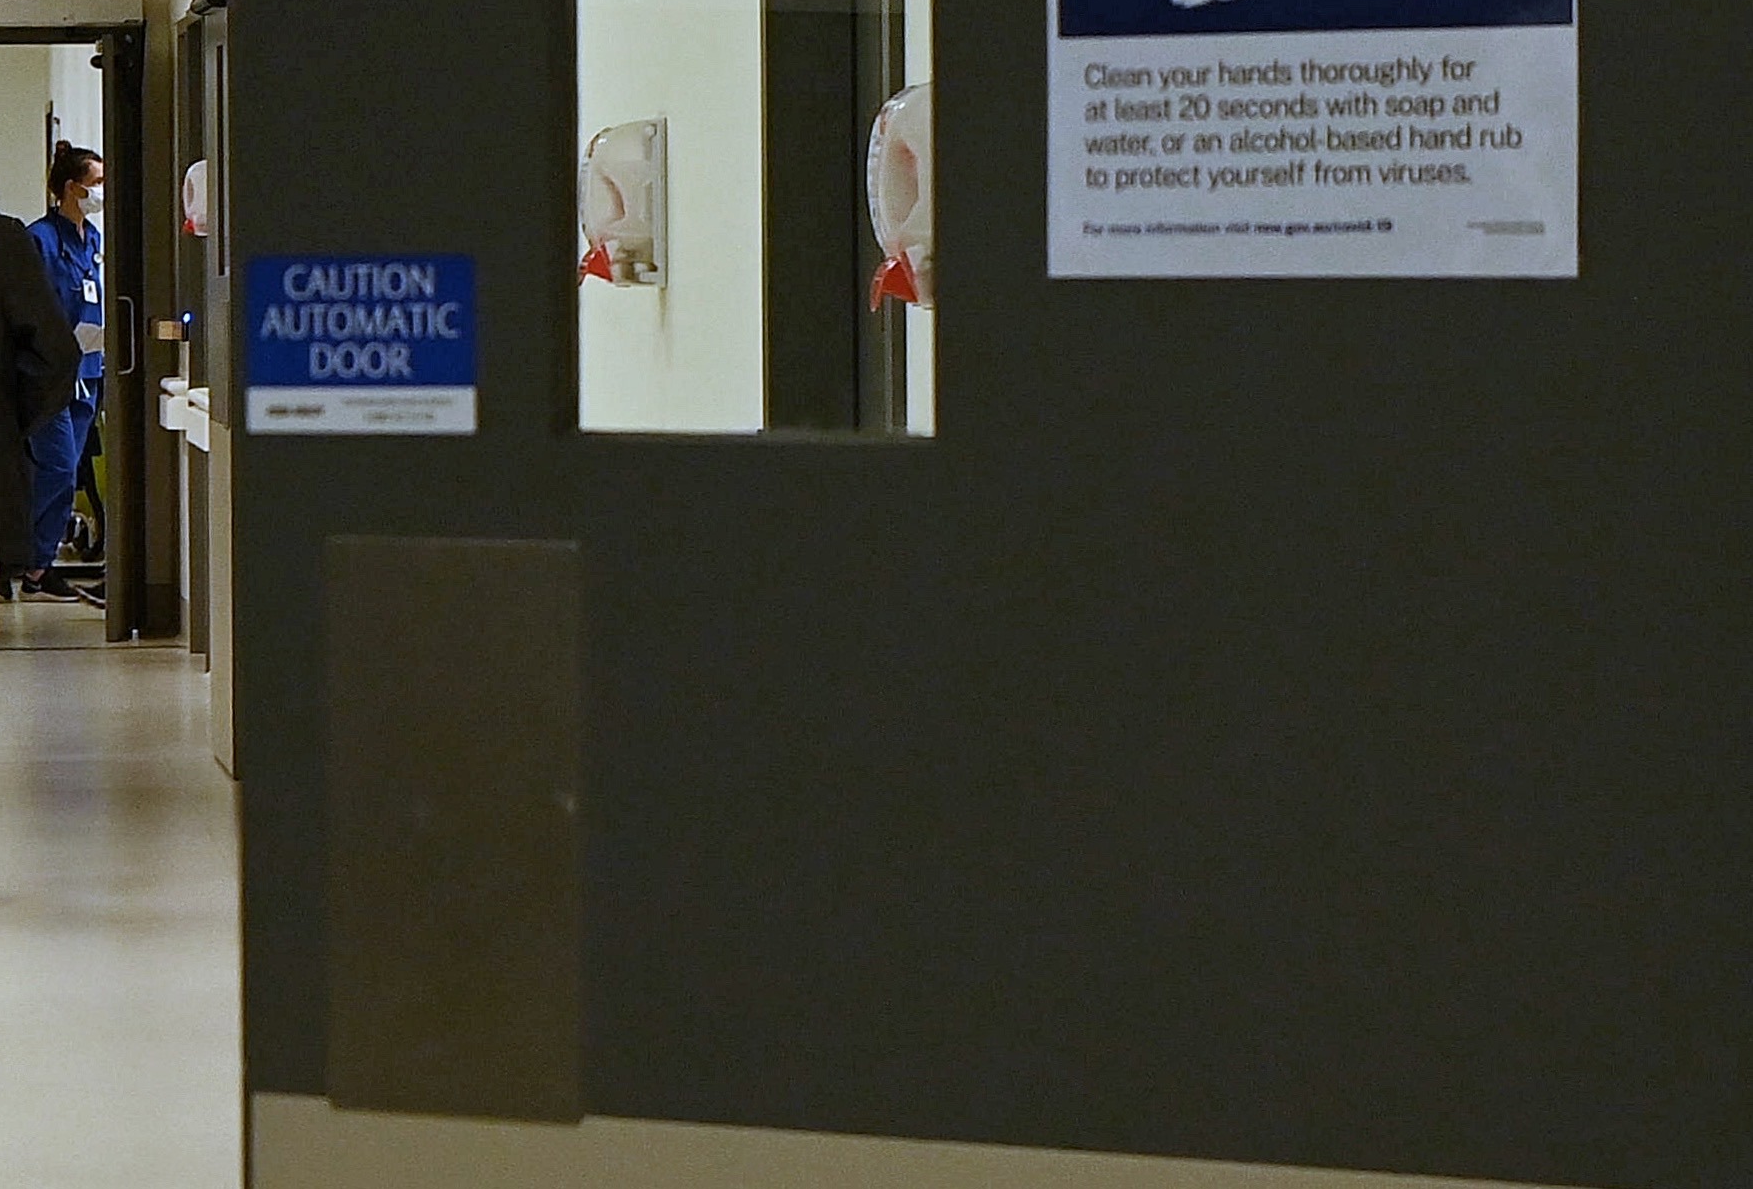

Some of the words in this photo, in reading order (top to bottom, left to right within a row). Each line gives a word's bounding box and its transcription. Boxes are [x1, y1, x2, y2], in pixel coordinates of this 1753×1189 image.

[1083, 61, 1152, 89] Clean
[1157, 65, 1212, 93] your
[1217, 57, 1293, 86] hands
[1300, 55, 1433, 88] thoroughly
[1441, 53, 1477, 82] for
[1083, 99, 1108, 123] at
[1113, 95, 1172, 122] least
[1177, 92, 1212, 121] 20
[1217, 91, 1319, 120] seconds
[1325, 90, 1379, 118] with
[1384, 93, 1445, 120] soap
[1451, 87, 1500, 116] and
[1083, 131, 1157, 158] water,
[1160, 131, 1187, 155] or
[1192, 132, 1223, 154] an
[1408, 121, 1472, 151] hand
[1478, 121, 1524, 149] rub
[1084, 166, 1108, 190] to
[1113, 164, 1200, 193] protect
[1206, 159, 1305, 193] yourself
[1312, 158, 1372, 187] from
[1377, 161, 1472, 187] viruses.
[282, 262, 436, 302] CAUTION
[259, 301, 461, 341] AUTOMATIC
[307, 340, 414, 380] DOOR
